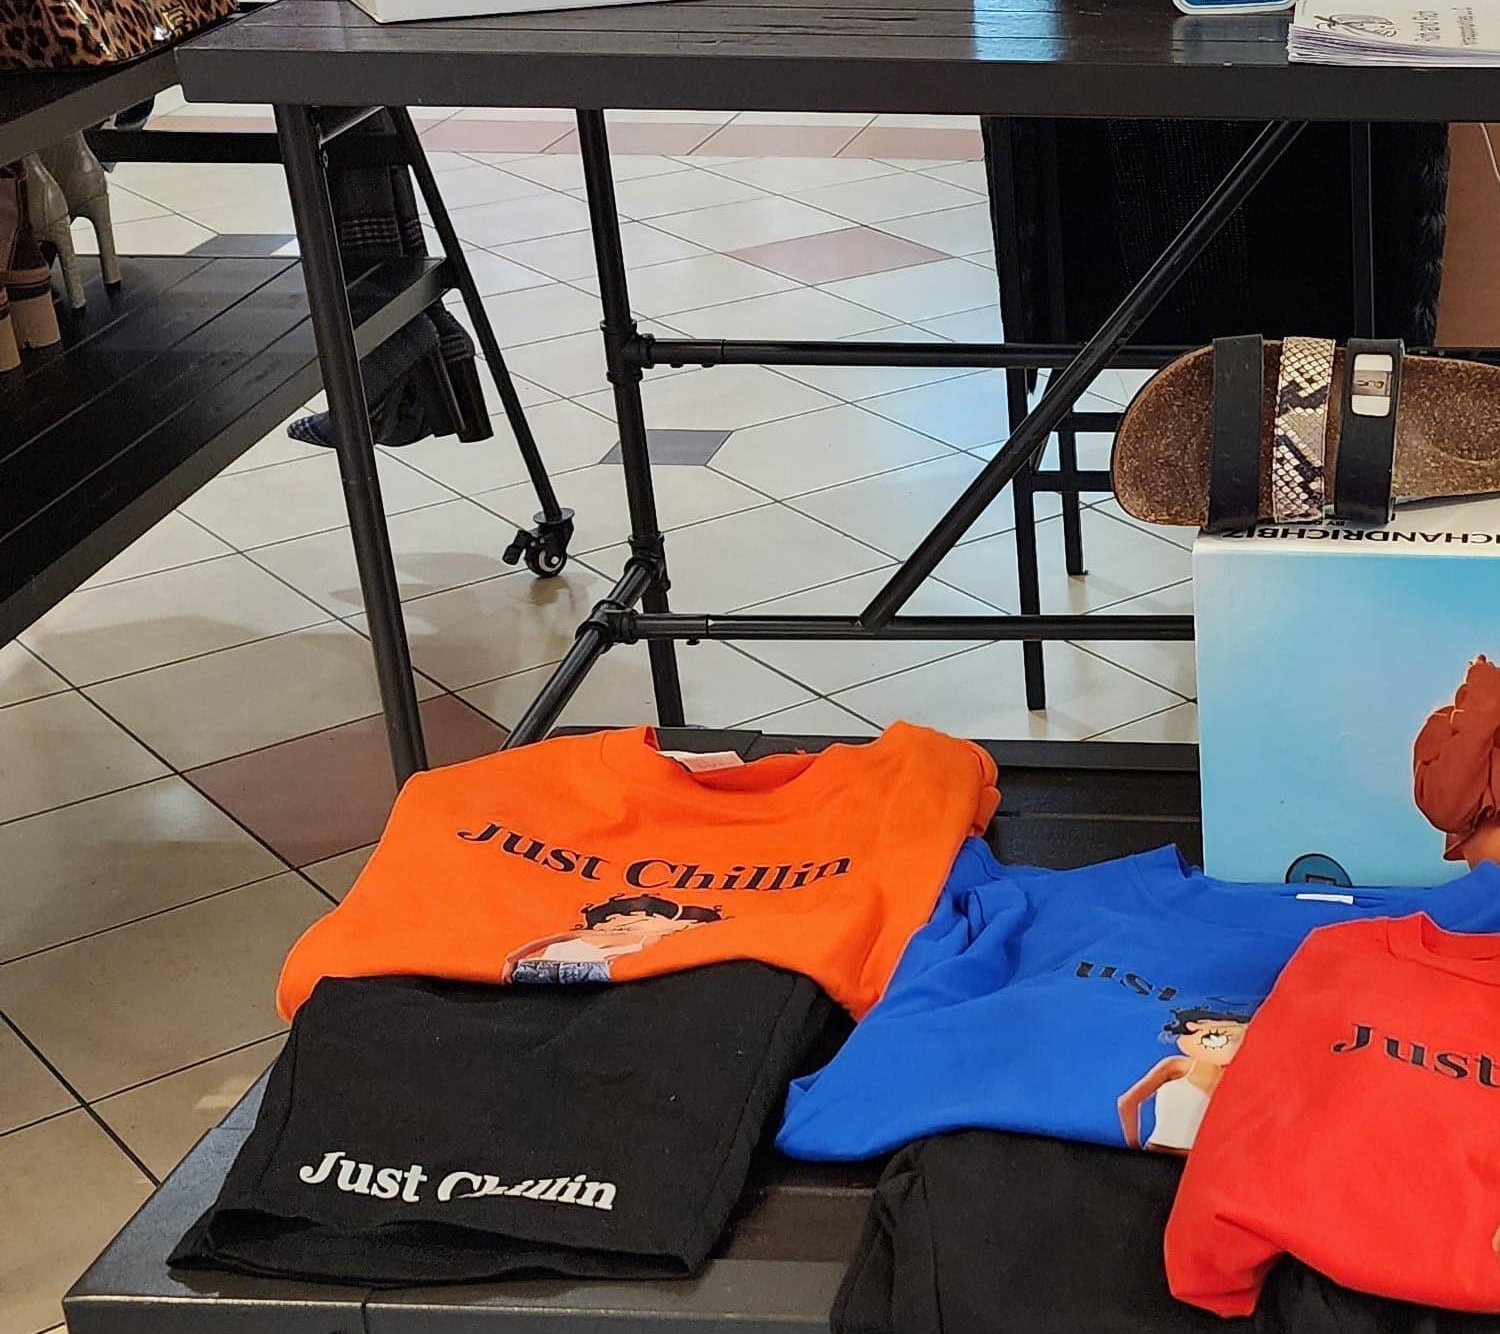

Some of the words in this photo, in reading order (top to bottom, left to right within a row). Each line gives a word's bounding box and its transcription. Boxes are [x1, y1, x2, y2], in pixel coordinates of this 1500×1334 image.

[455, 820, 613, 883] Just
[624, 855, 852, 892] Chillin
[1075, 961, 1180, 1002] ust
[298, 1151, 428, 1203] Just
[436, 1170, 618, 1210] Chillin
